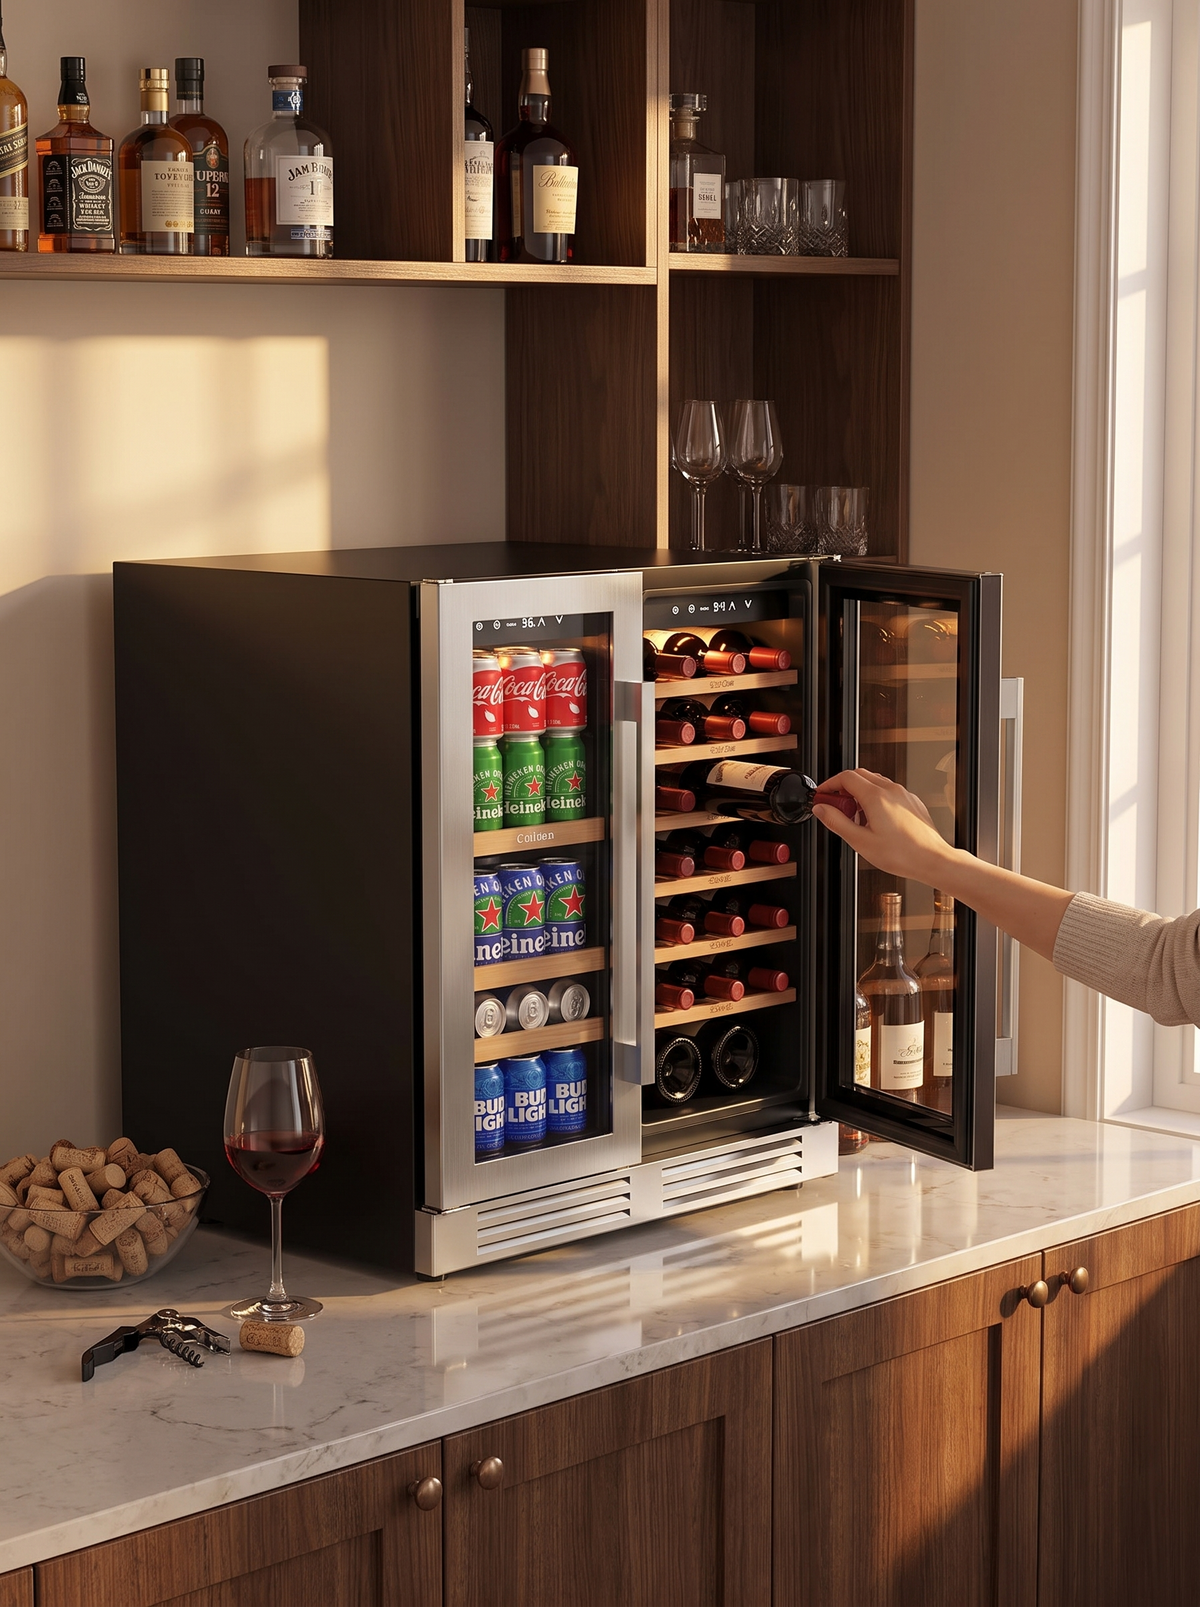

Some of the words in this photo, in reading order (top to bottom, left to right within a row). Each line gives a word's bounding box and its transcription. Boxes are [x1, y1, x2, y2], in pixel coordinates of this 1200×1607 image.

[206, 183, 219, 197] 12
[514, 1087, 547, 1107] BUD
[555, 1079, 588, 1099] BUD
[474, 1096, 505, 1116] BUD
